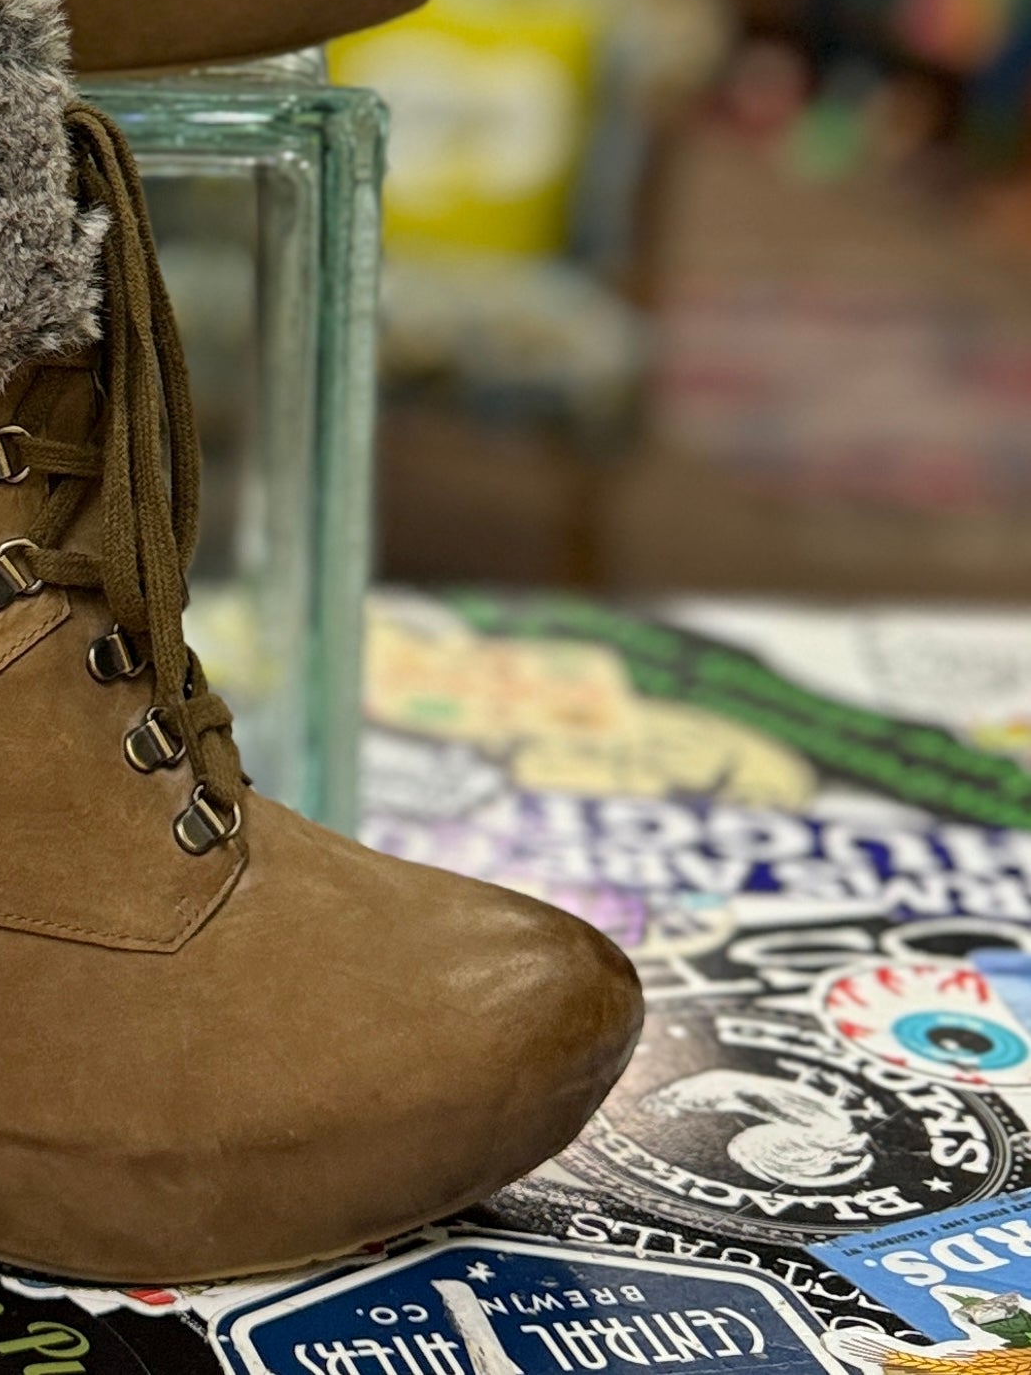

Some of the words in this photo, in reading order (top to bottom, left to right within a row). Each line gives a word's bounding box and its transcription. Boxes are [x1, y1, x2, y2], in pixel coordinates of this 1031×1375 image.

[356, 1304, 429, 1325] CO.
[480, 1284, 646, 1317] BREWIN
[294, 1332, 463, 1375] ATERS
[521, 1307, 765, 1371] CENTRAL
